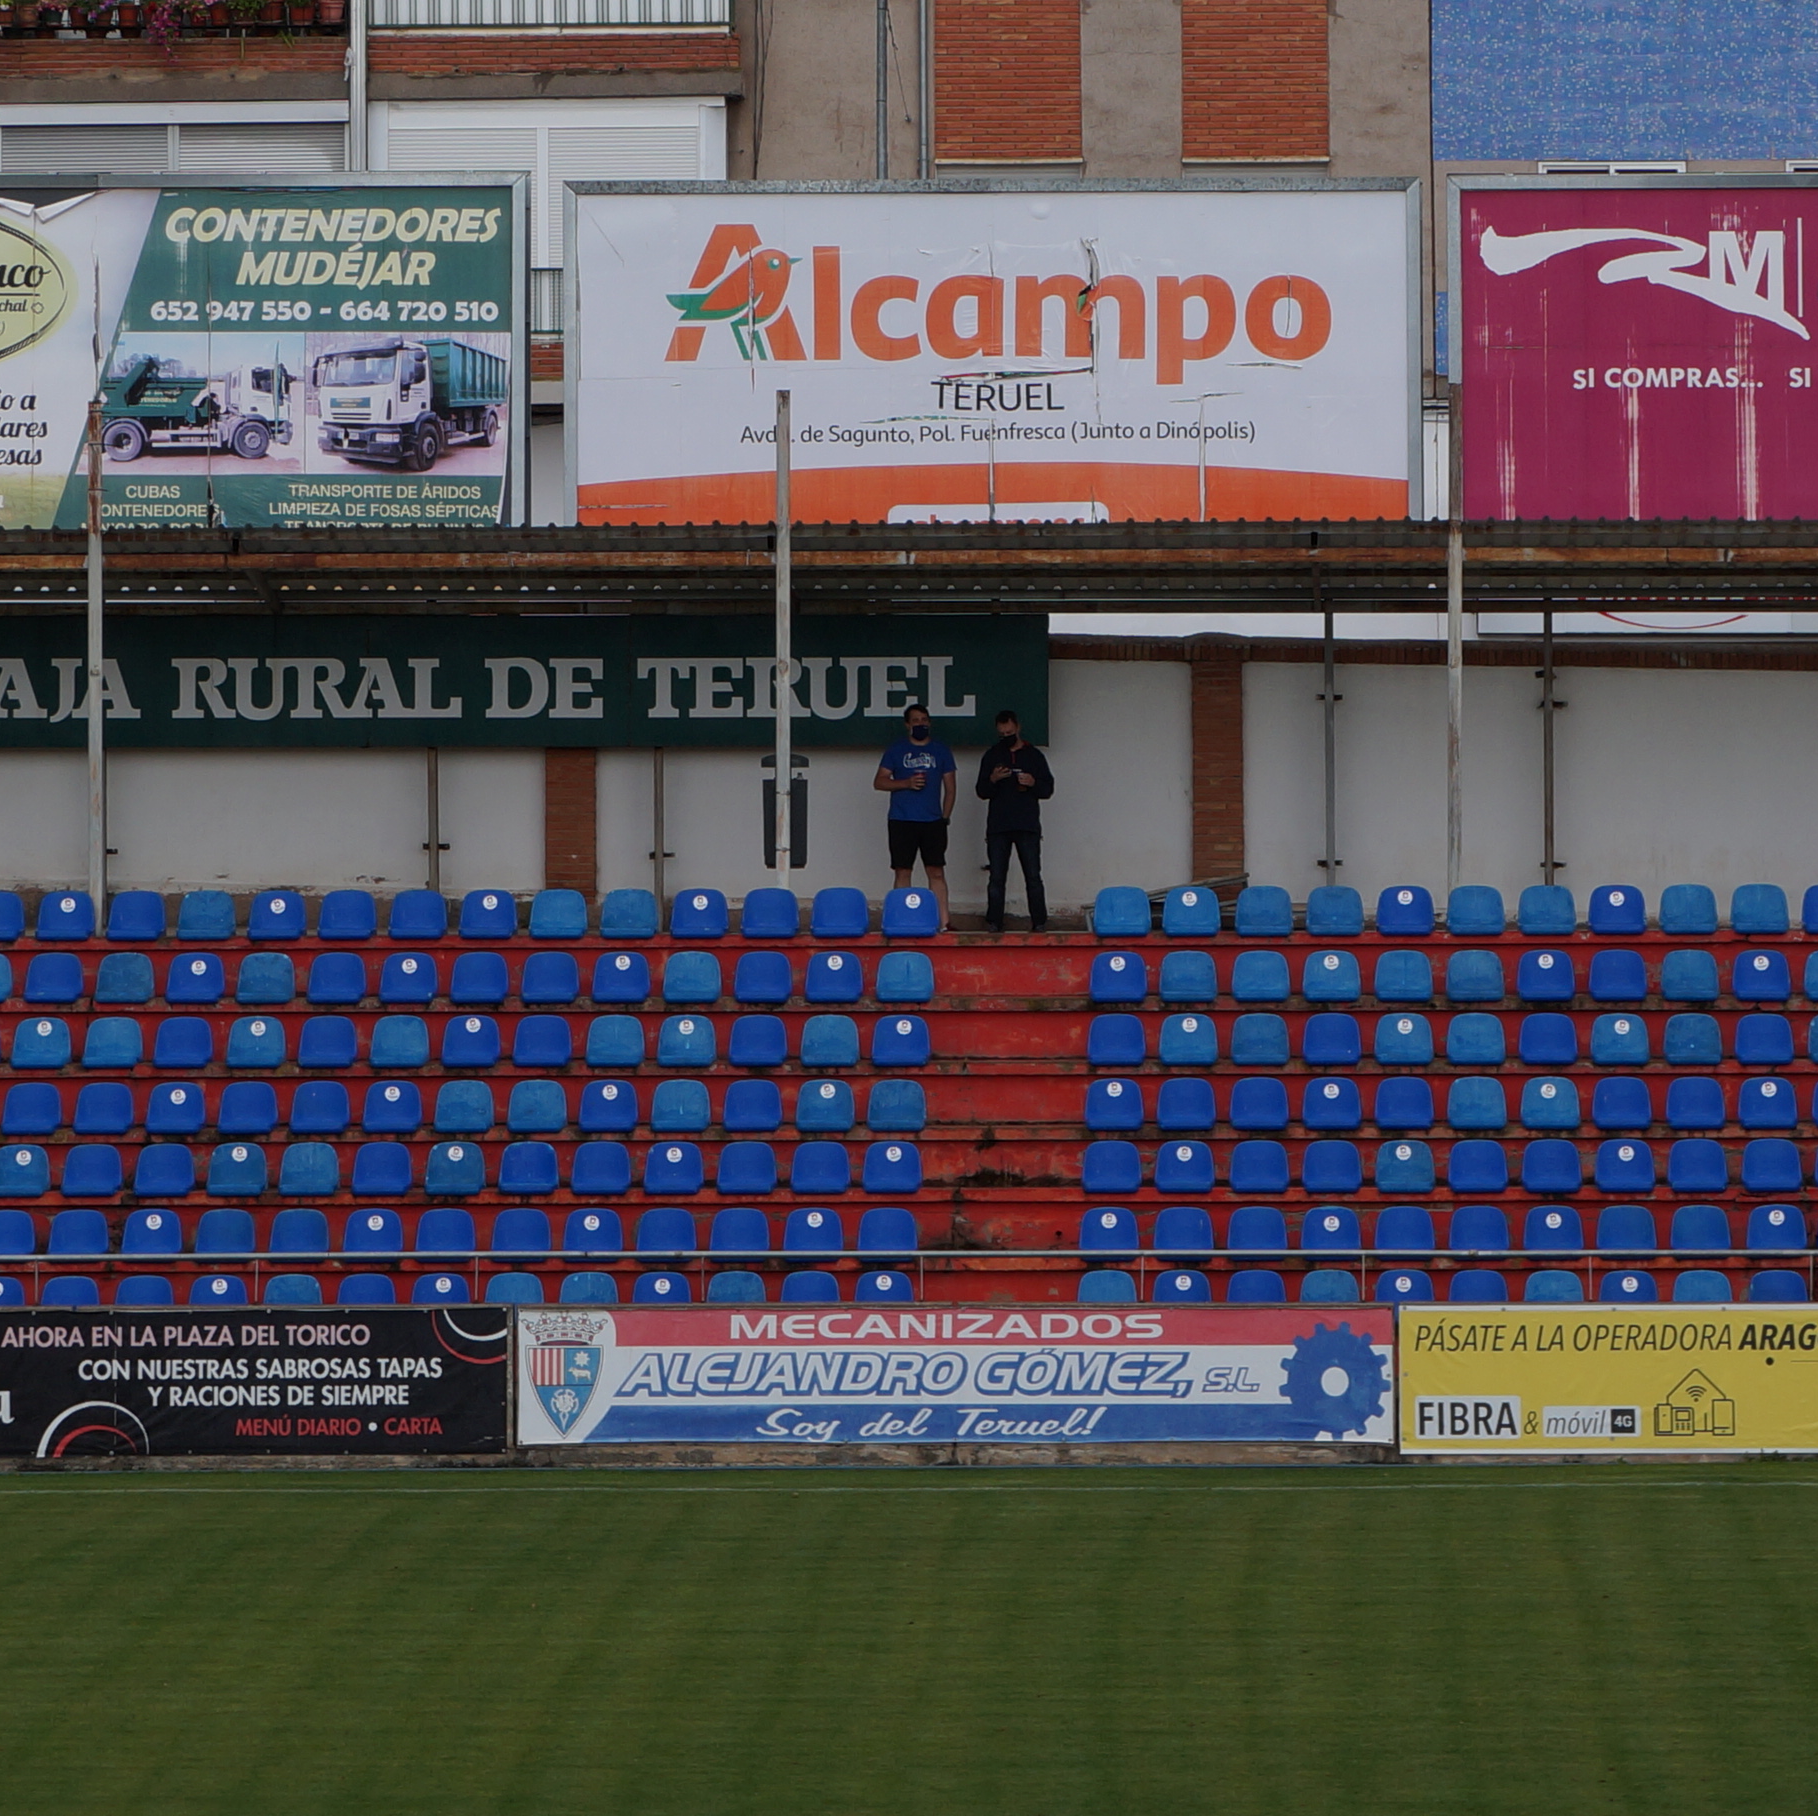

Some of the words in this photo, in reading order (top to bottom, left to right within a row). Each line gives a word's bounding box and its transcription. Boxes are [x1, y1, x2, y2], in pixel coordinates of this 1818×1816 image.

[164, 207, 502, 243] CONTENEDORES
[235, 243, 436, 290] MUDÉJAR
[150, 300, 199, 322] 652
[206, 300, 254, 322] 947
[261, 300, 311, 322] 550
[339, 300, 390, 322] 664
[397, 300, 447, 322] 720
[454, 300, 499, 322] 510
[664, 223, 1332, 385] Alcampo
[1573, 367, 1596, 389] SI
[1789, 367, 1811, 388] SI
[931, 380, 1064, 411] TERUEL
[800, 425, 823, 443] de
[829, 425, 914, 447] Sagunto,
[920, 425, 955, 443] Pol.
[961, 422, 1065, 441] Fuenfresca
[1072, 421, 1134, 443] (Junto
[1156, 420, 1256, 444] Dinópolis)
[125, 485, 181, 499] CUBAS
[288, 484, 392, 499] TRANSPORTE
[396, 484, 417, 499] DE
[421, 482, 481, 499] ÁRIDOS
[269, 502, 341, 517] LIMPIEZA
[345, 503, 366, 517] DE
[370, 503, 421, 517] FOSAS
[425, 501, 499, 518] SÉPTICAS
[171, 655, 463, 720] RURAL
[485, 656, 603, 719] DE
[636, 655, 977, 720] TERUEL
[0, 1326, 84, 1348] AHORA
[91, 1326, 123, 1347] EN
[130, 1326, 157, 1346] LA
[164, 1325, 234, 1346] PLAZA
[241, 1325, 280, 1346] DEL
[285, 1324, 370, 1346] TORICO
[730, 1313, 1163, 1339] MECANIZADOS
[1414, 1318, 1506, 1352] PÁSATE
[1511, 1324, 1527, 1351] A
[1536, 1324, 1565, 1351] LA
[1572, 1324, 1732, 1351] OPERADORA
[78, 1359, 130, 1381] CON
[138, 1358, 249, 1380] NUESTRAS
[255, 1358, 371, 1380] SABROSAS
[378, 1357, 442, 1378] TAPAS
[613, 1351, 968, 1397] ALEJANDRO
[974, 1348, 1194, 1399] GÓMEZ,
[1201, 1367, 1260, 1392] S.L.
[169, 1385, 280, 1406] RACIONES
[287, 1385, 314, 1406] DE
[321, 1384, 409, 1405] SIEMPRE
[235, 1414, 291, 1436] MENÚ
[298, 1418, 362, 1435] DIARIO
[384, 1417, 442, 1435] CARTA
[756, 1408, 841, 1442] Soy
[859, 1408, 932, 1436] del
[956, 1406, 1108, 1436] Teruel!
[1418, 1401, 1518, 1436] FIBRA
[1546, 1409, 1608, 1435] móvil
